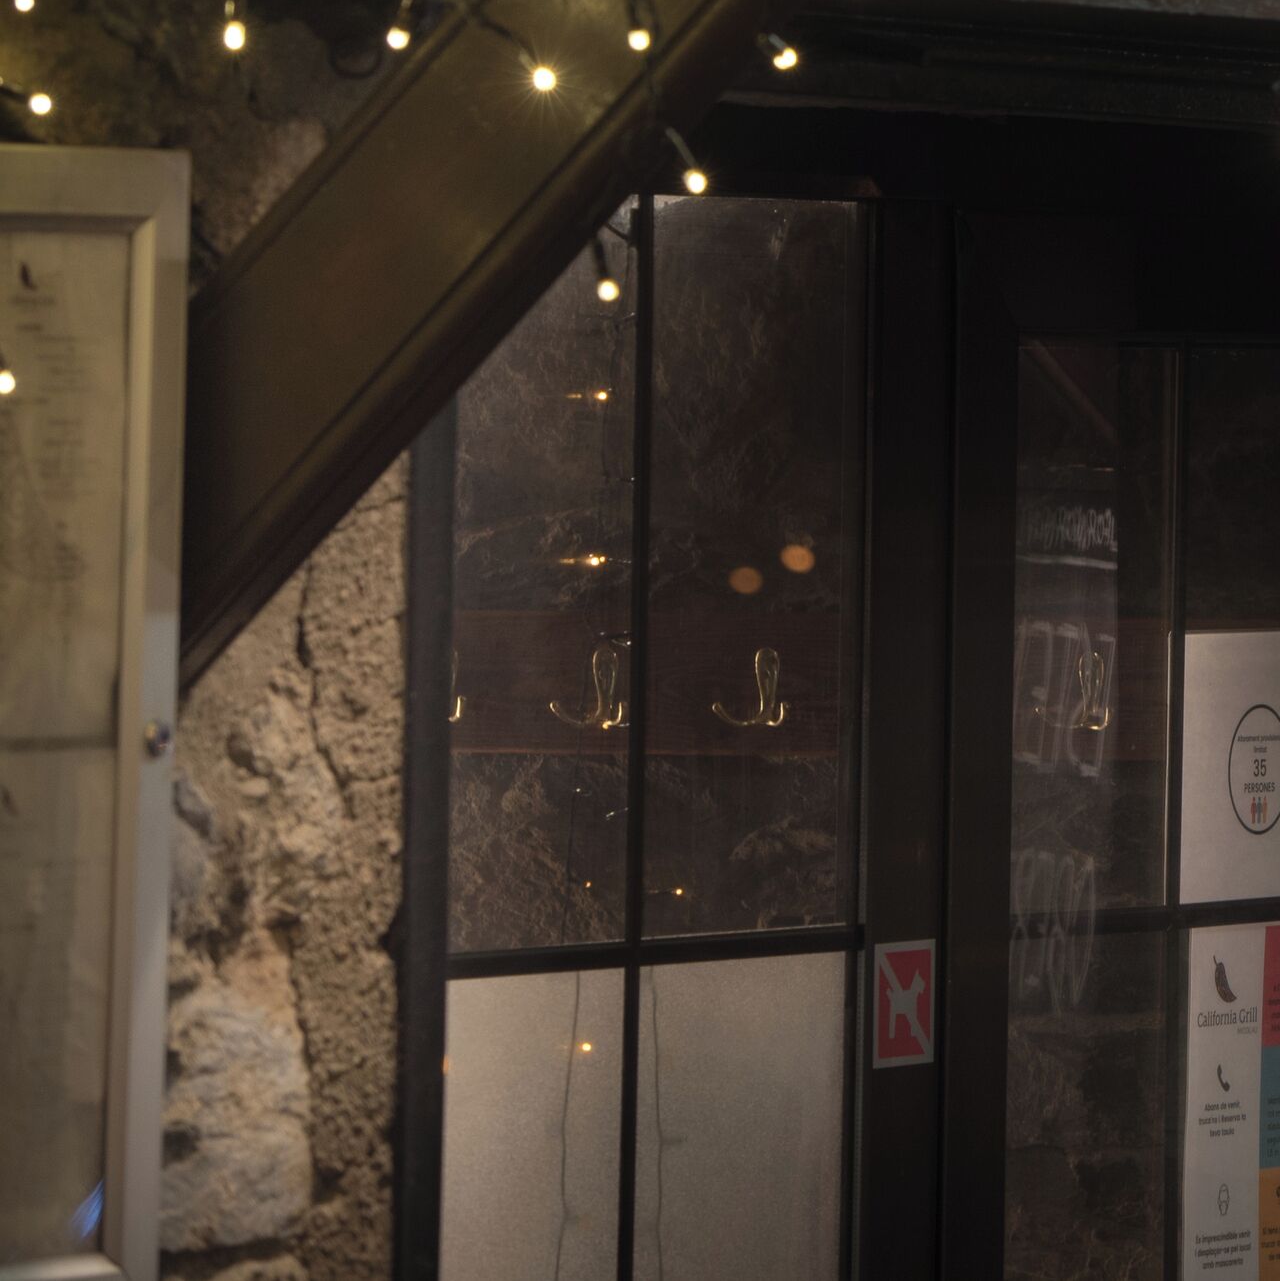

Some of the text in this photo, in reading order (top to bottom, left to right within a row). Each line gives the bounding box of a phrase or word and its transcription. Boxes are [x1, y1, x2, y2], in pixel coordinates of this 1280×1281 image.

[1253, 758, 1267, 777] 35
[1243, 781, 1276, 794] PERSONES
[1197, 1009, 1237, 1029] California
[1239, 1005, 1258, 1024] Grill
